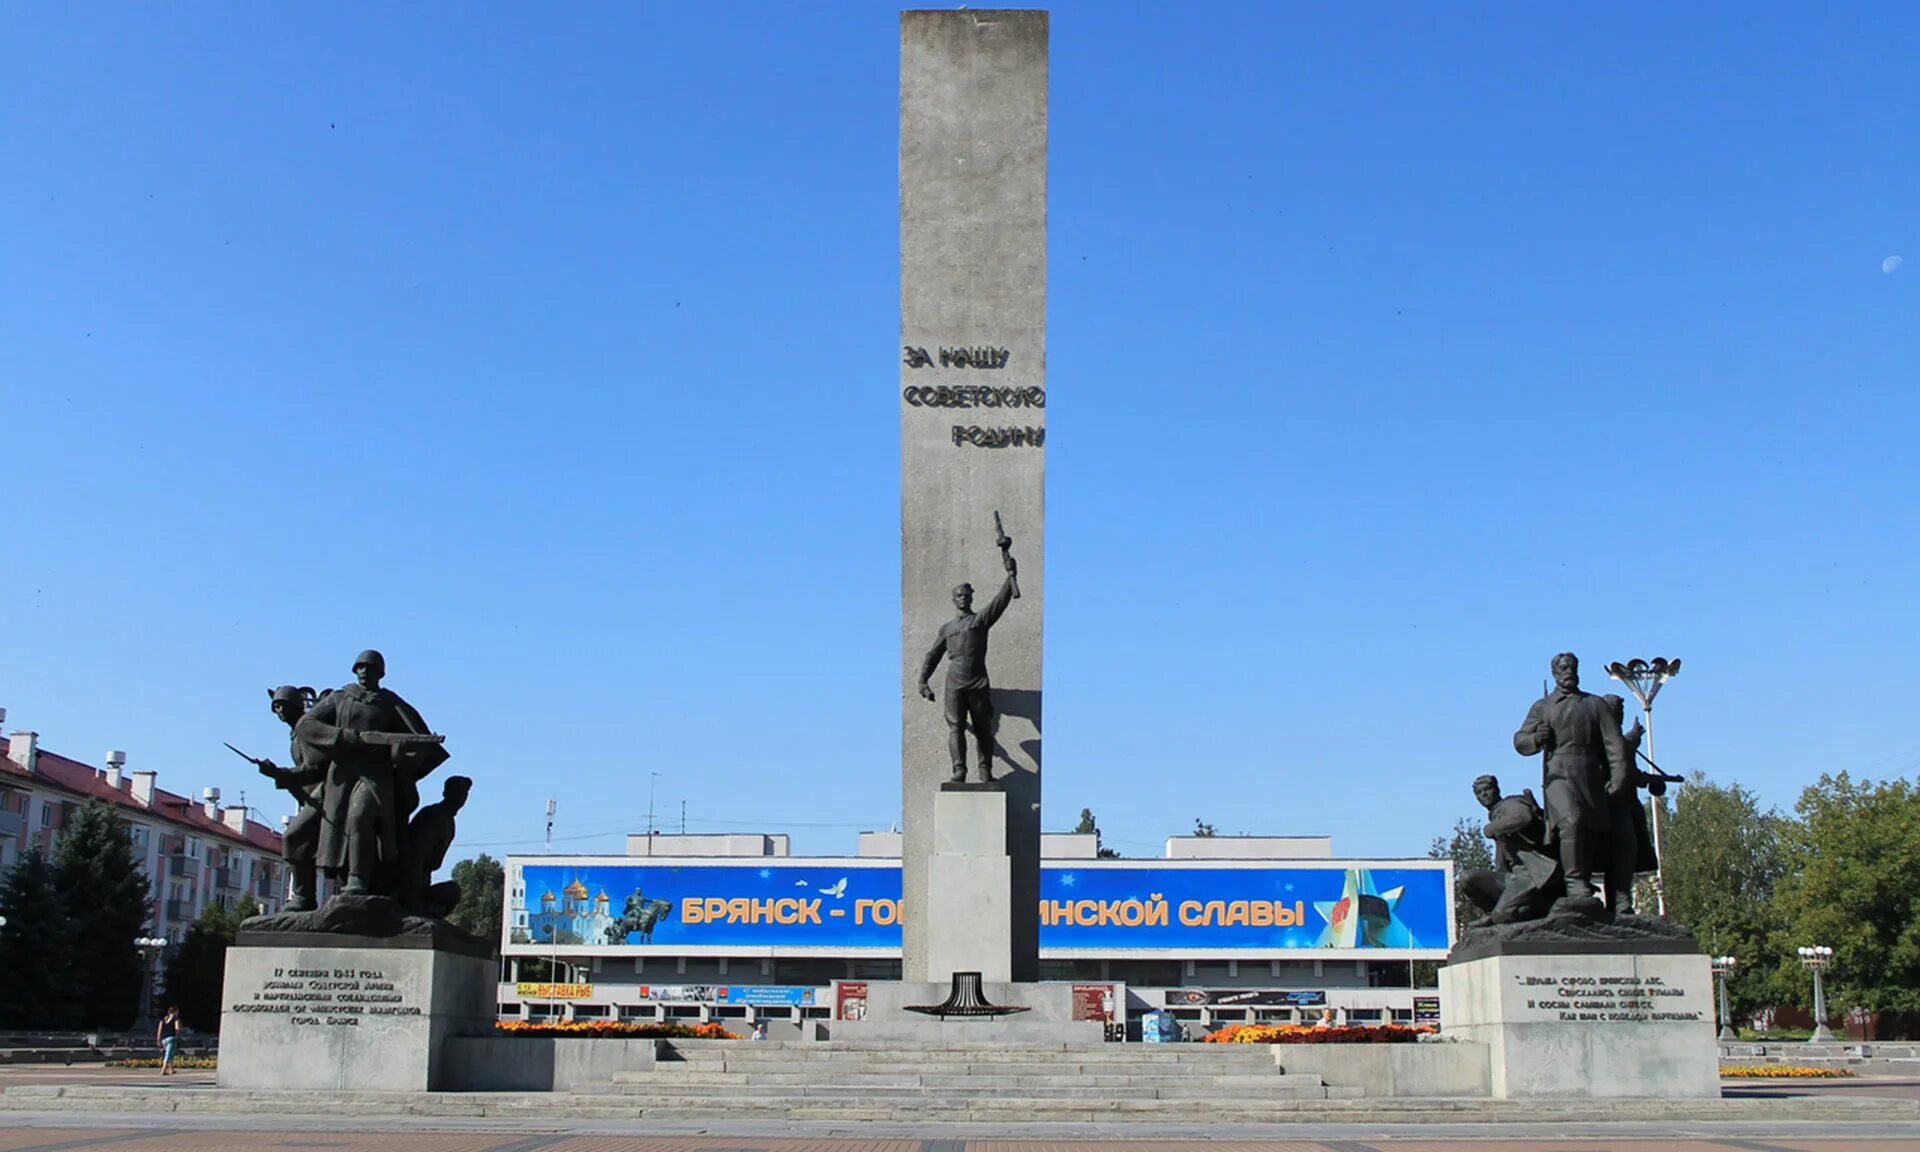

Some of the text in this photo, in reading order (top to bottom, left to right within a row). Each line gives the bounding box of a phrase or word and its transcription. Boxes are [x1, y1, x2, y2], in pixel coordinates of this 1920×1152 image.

[903, 345, 1010, 369] ЗА НАШУ
[903, 385, 1046, 408] СОВЕТСКУЮ
[952, 425, 1046, 448] РОДИНУ
[681, 897, 823, 925] БРЯНСК
[1178, 899, 1305, 927] СЛАВЫ
[359, 969, 385, 979] ГОДА
